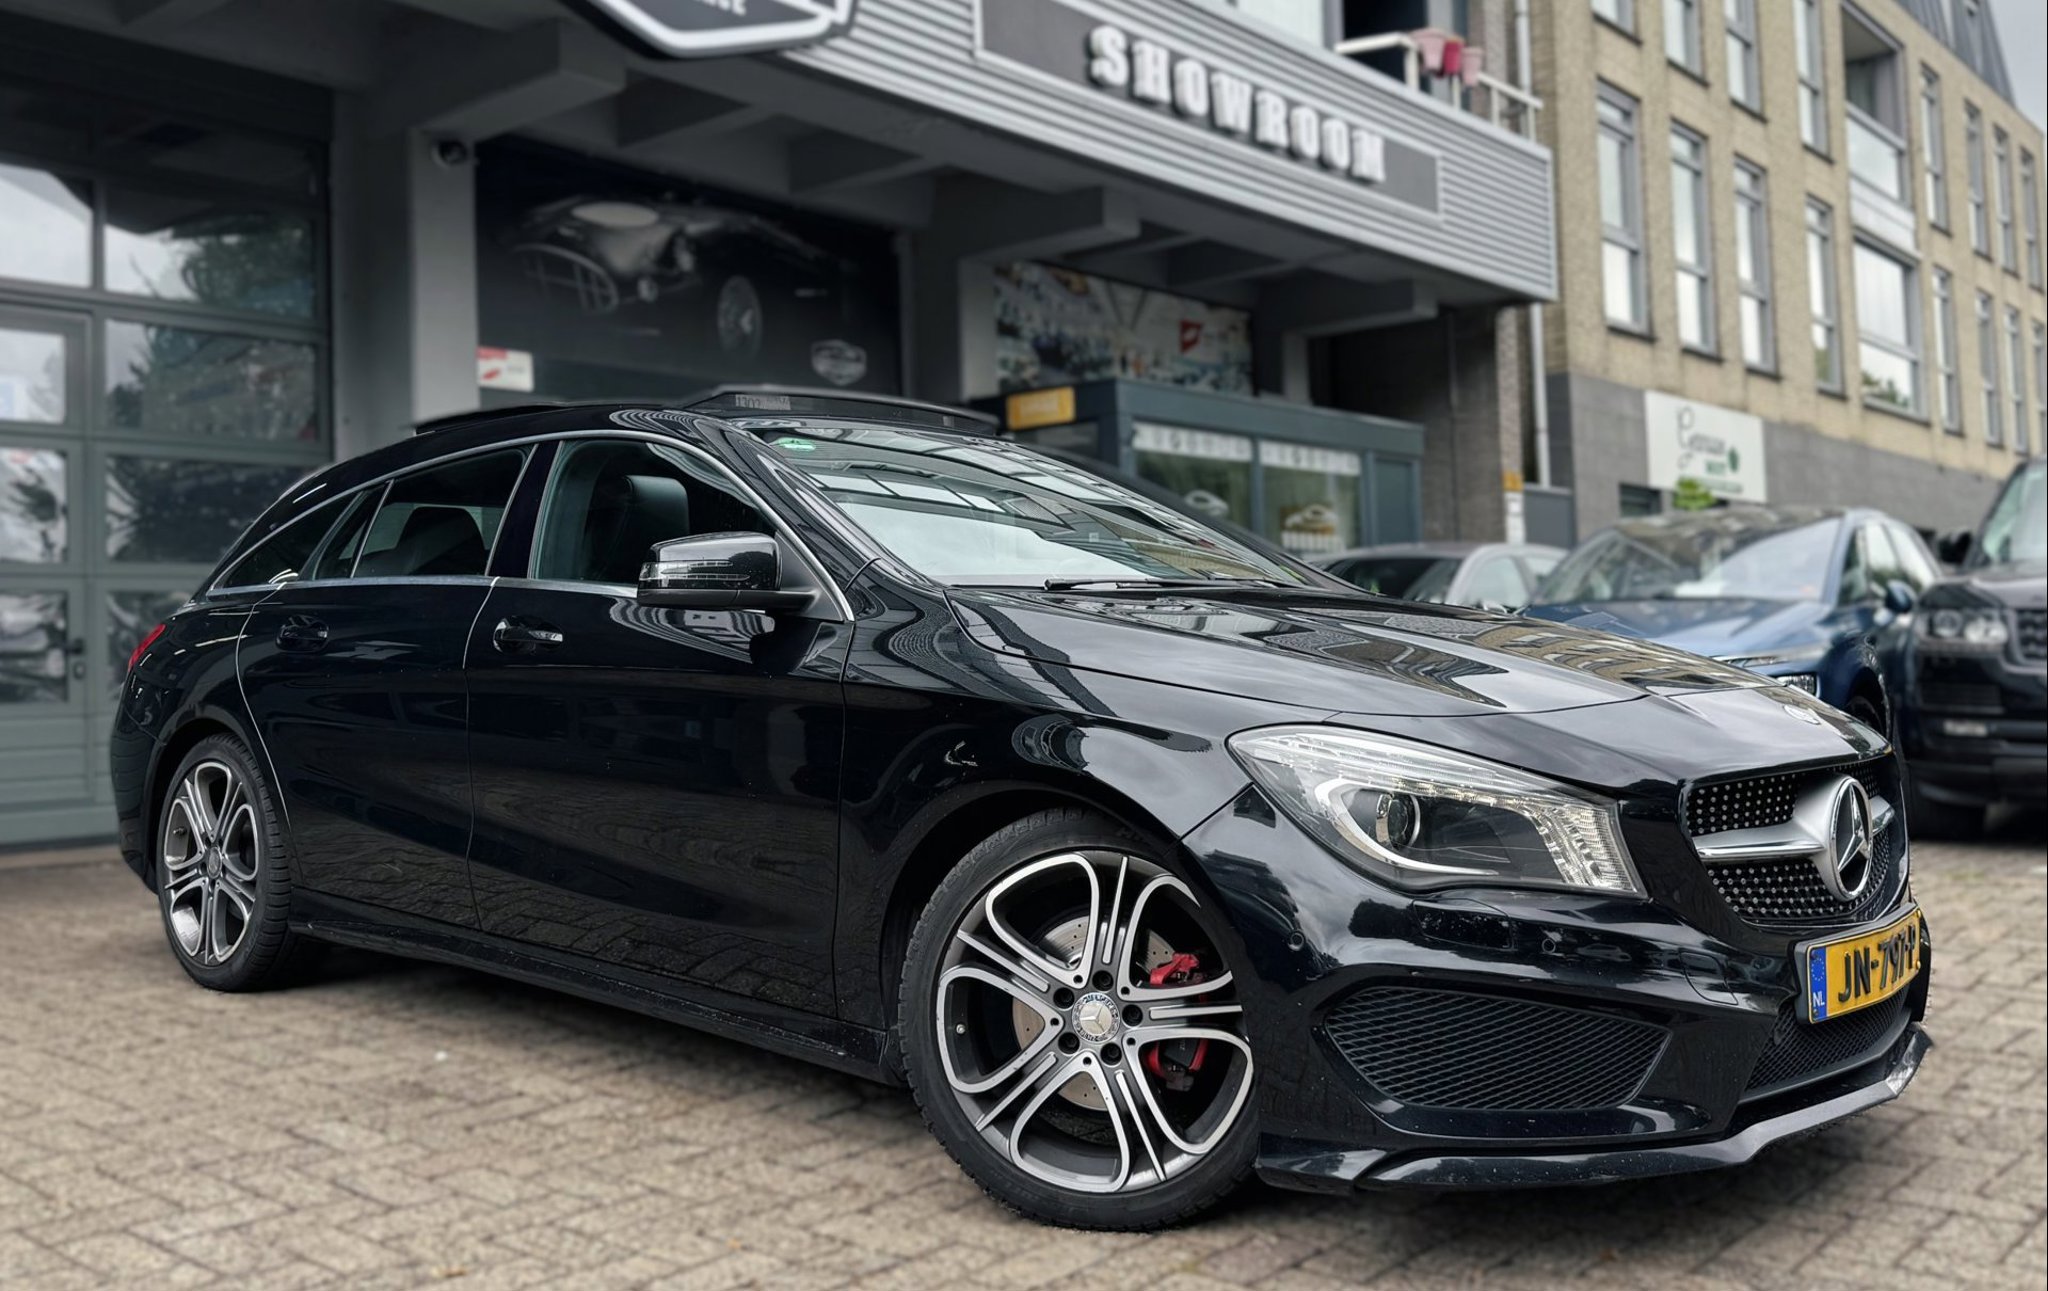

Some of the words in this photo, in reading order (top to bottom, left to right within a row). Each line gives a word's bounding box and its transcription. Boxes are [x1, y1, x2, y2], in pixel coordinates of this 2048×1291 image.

[1089, 24, 1386, 182] SHOWROOM
[1812, 990, 1826, 1008] NL
[1838, 924, 1916, 1003] JN-797-P
